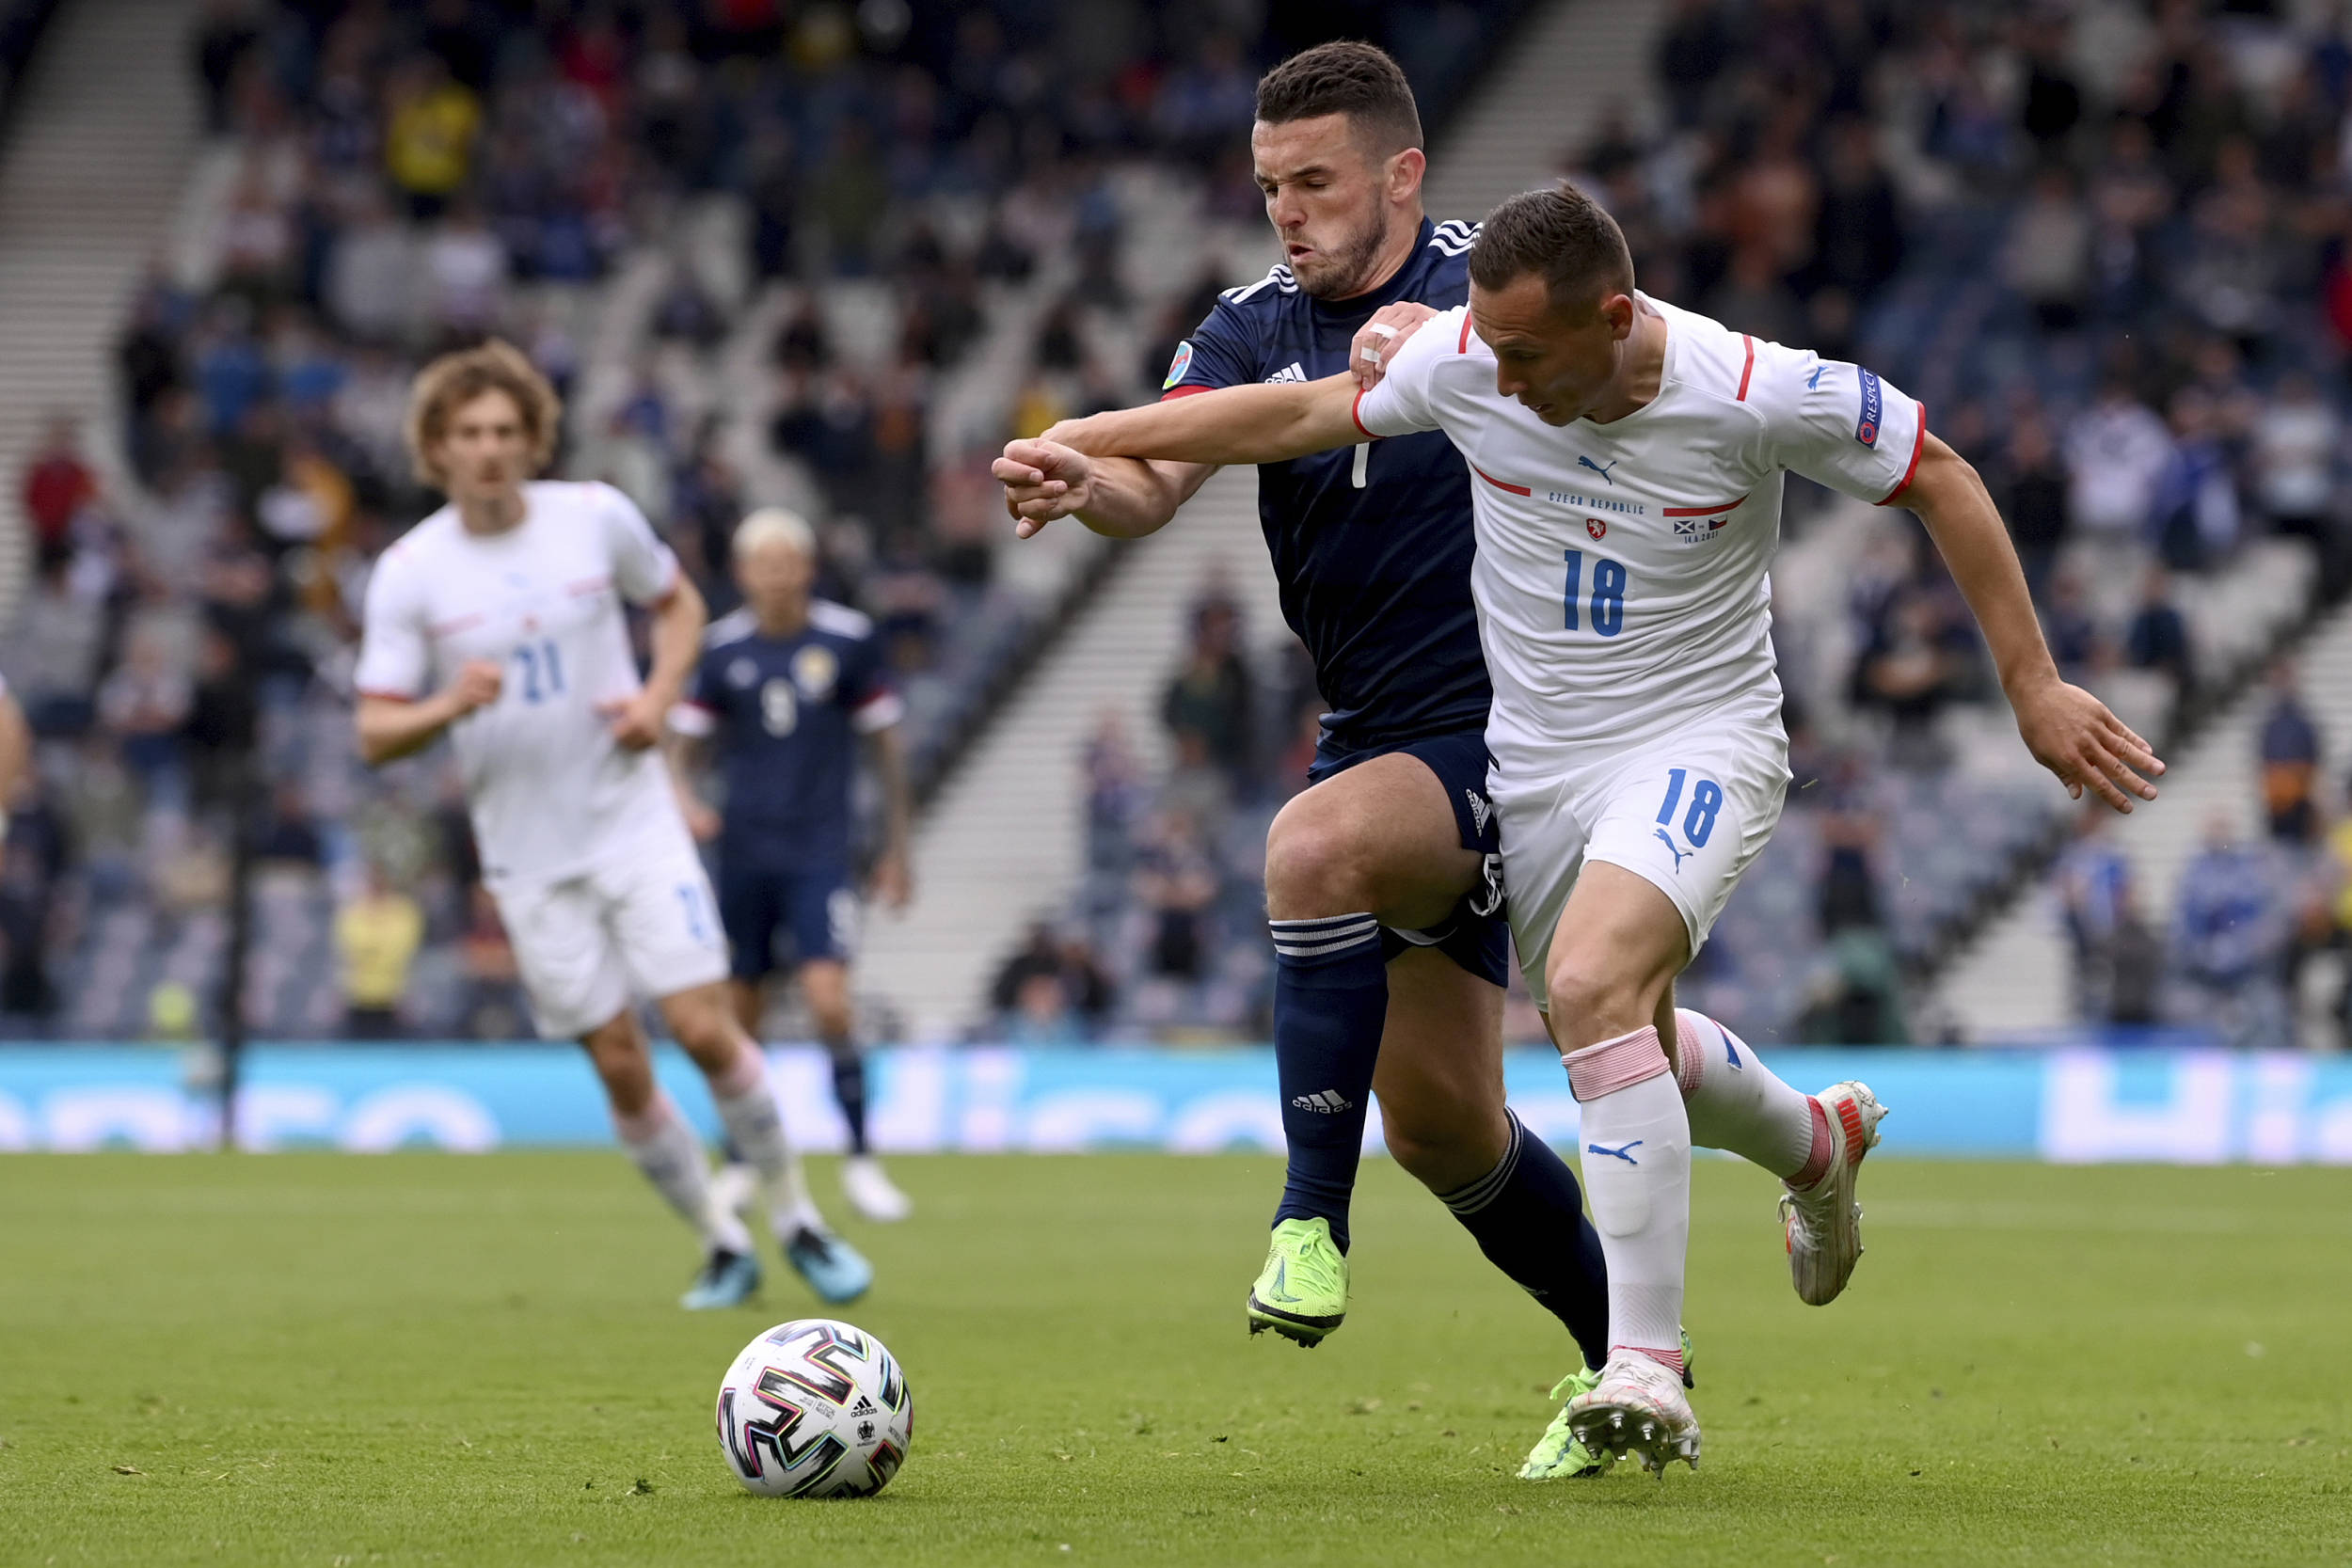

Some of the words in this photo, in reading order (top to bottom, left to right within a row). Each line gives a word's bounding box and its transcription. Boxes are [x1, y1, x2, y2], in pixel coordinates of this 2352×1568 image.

[1864, 368, 1878, 422] RESPECT
[1549, 491, 1583, 506] CZECH
[1590, 498, 1645, 515] REPUBLIC
[1564, 549, 1627, 637] 18
[512, 637, 564, 704] 21
[1466, 788, 1483, 838] adidas
[1656, 768, 1723, 848] 18
[1292, 1099, 1353, 1114] adidas
[850, 1407, 878, 1418] adidas
